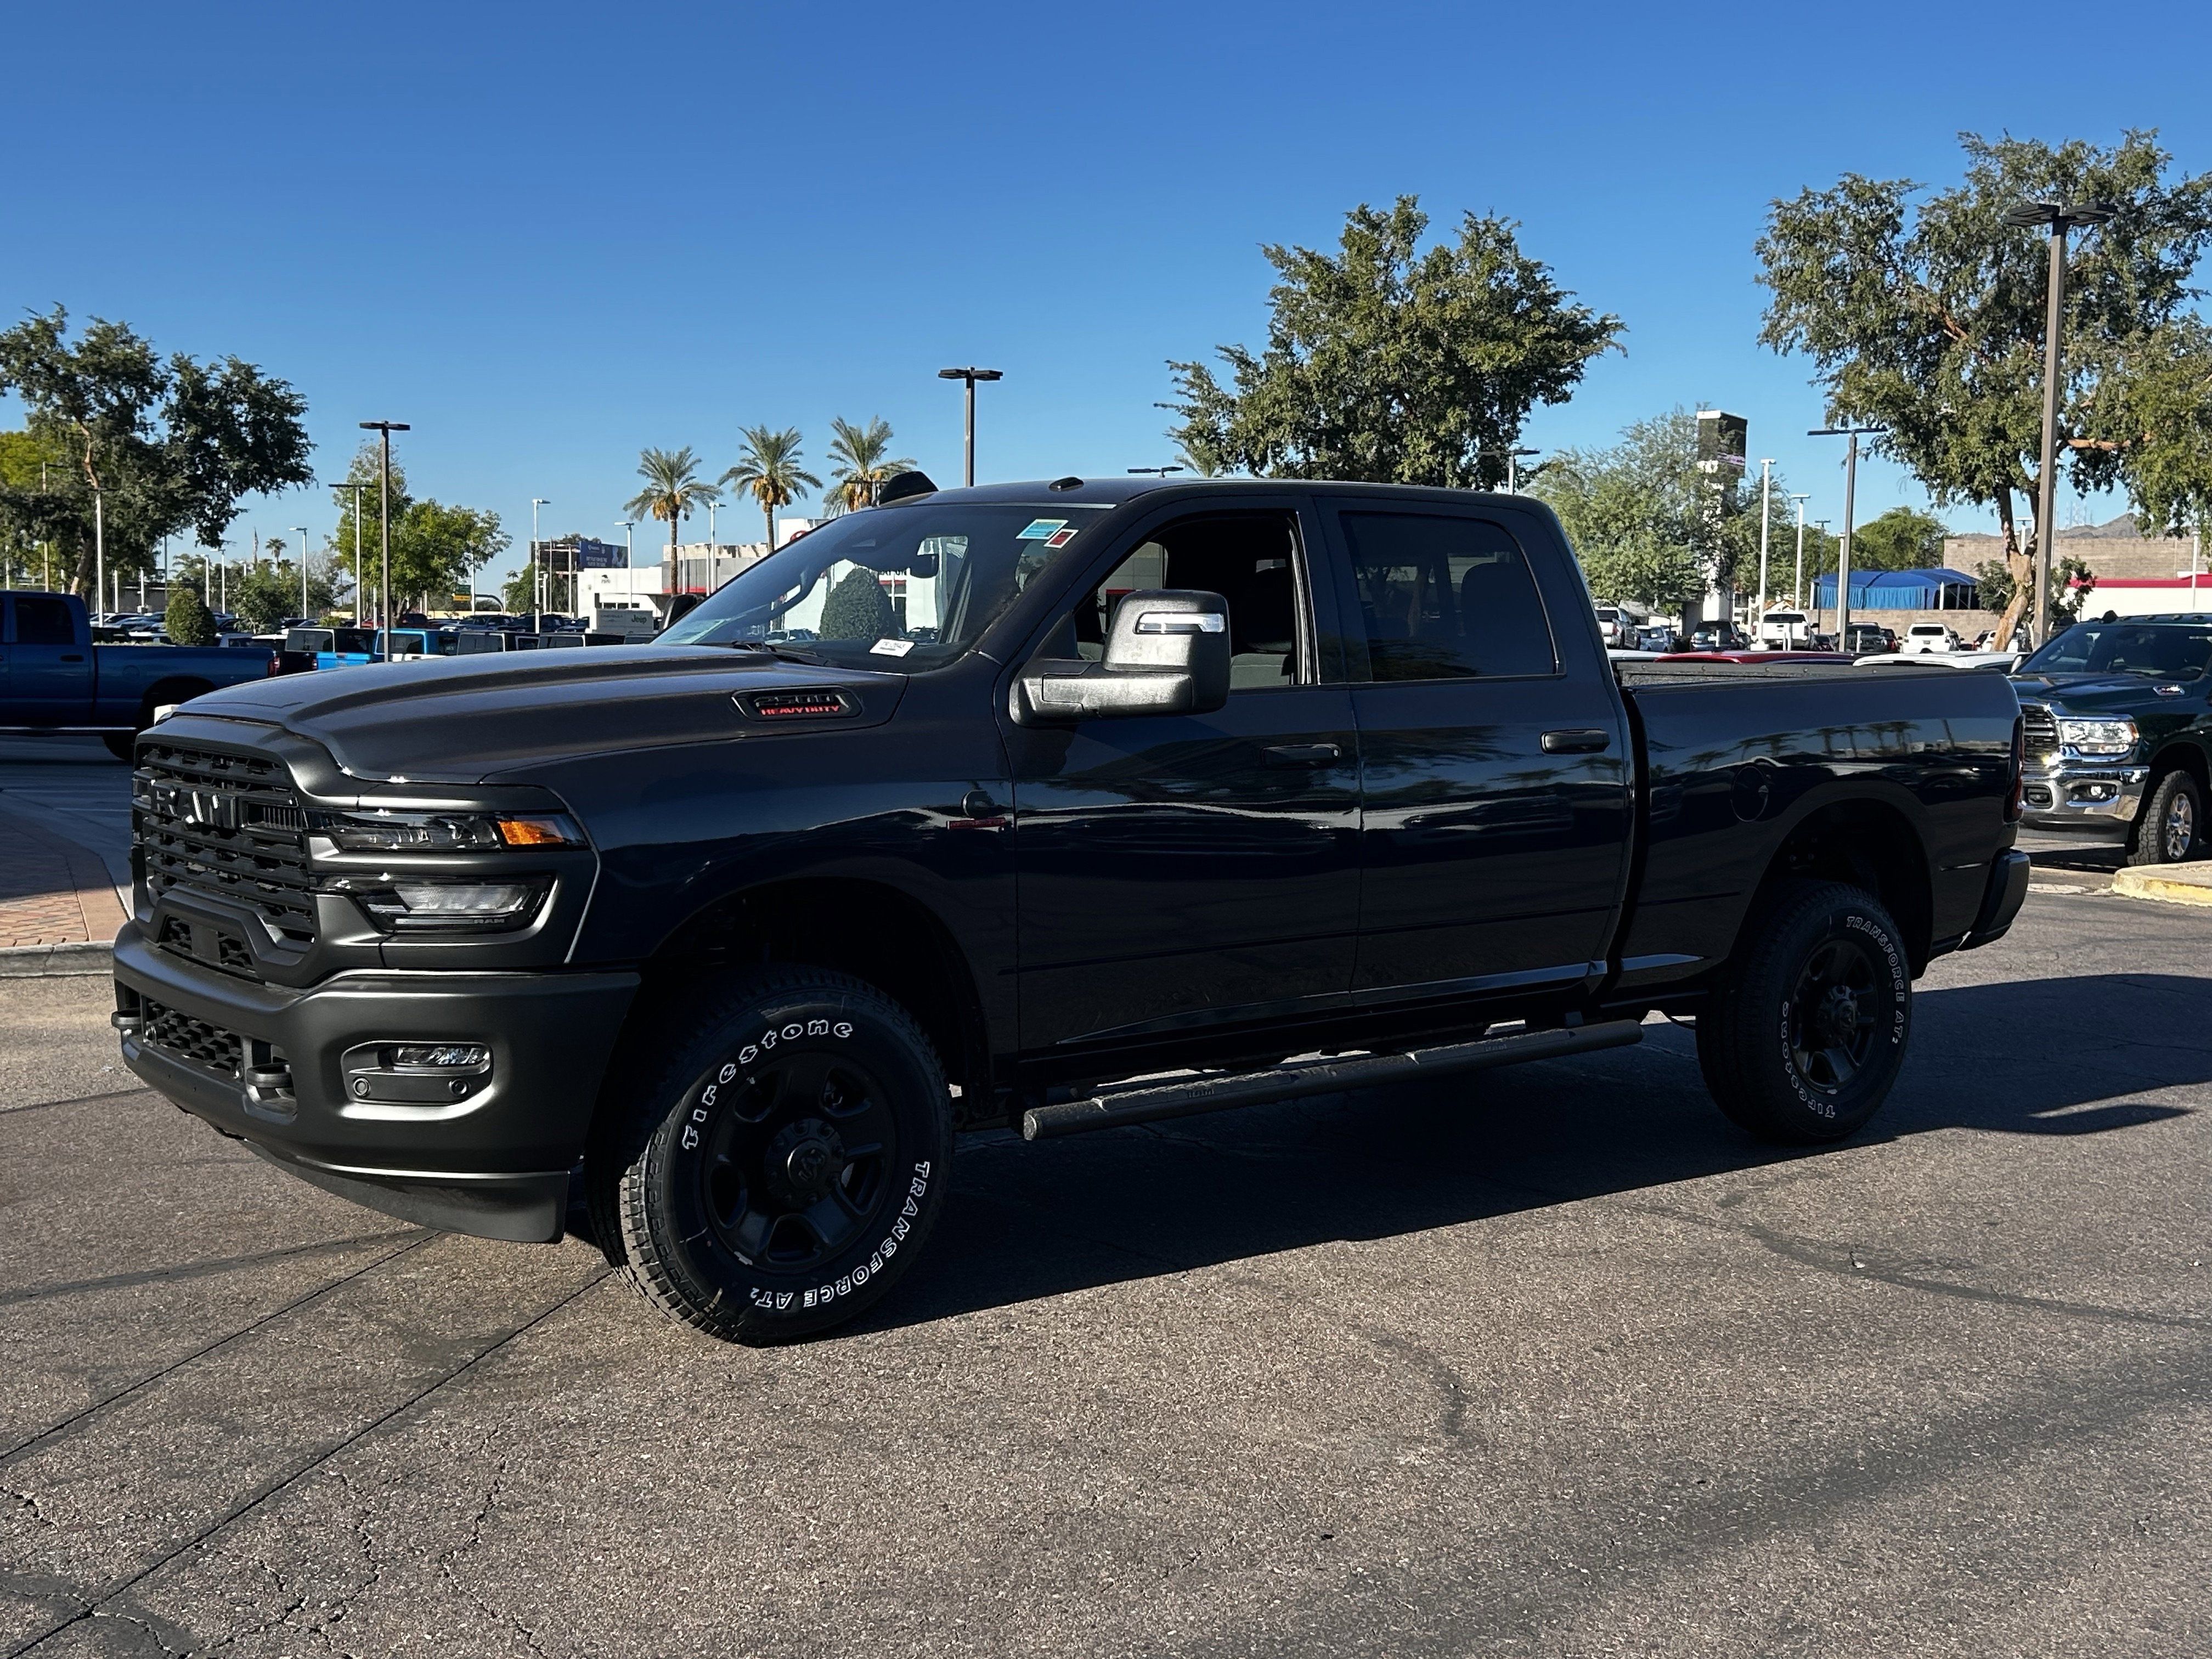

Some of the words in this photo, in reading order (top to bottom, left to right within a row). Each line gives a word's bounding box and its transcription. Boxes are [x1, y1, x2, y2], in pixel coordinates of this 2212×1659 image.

[154, 788, 238, 830] RAM
[1846, 916, 1905, 1002] TRANSFORCE
[682, 1019, 853, 1150] Firestone
[803, 1161, 930, 1307] TRANSFORCE
